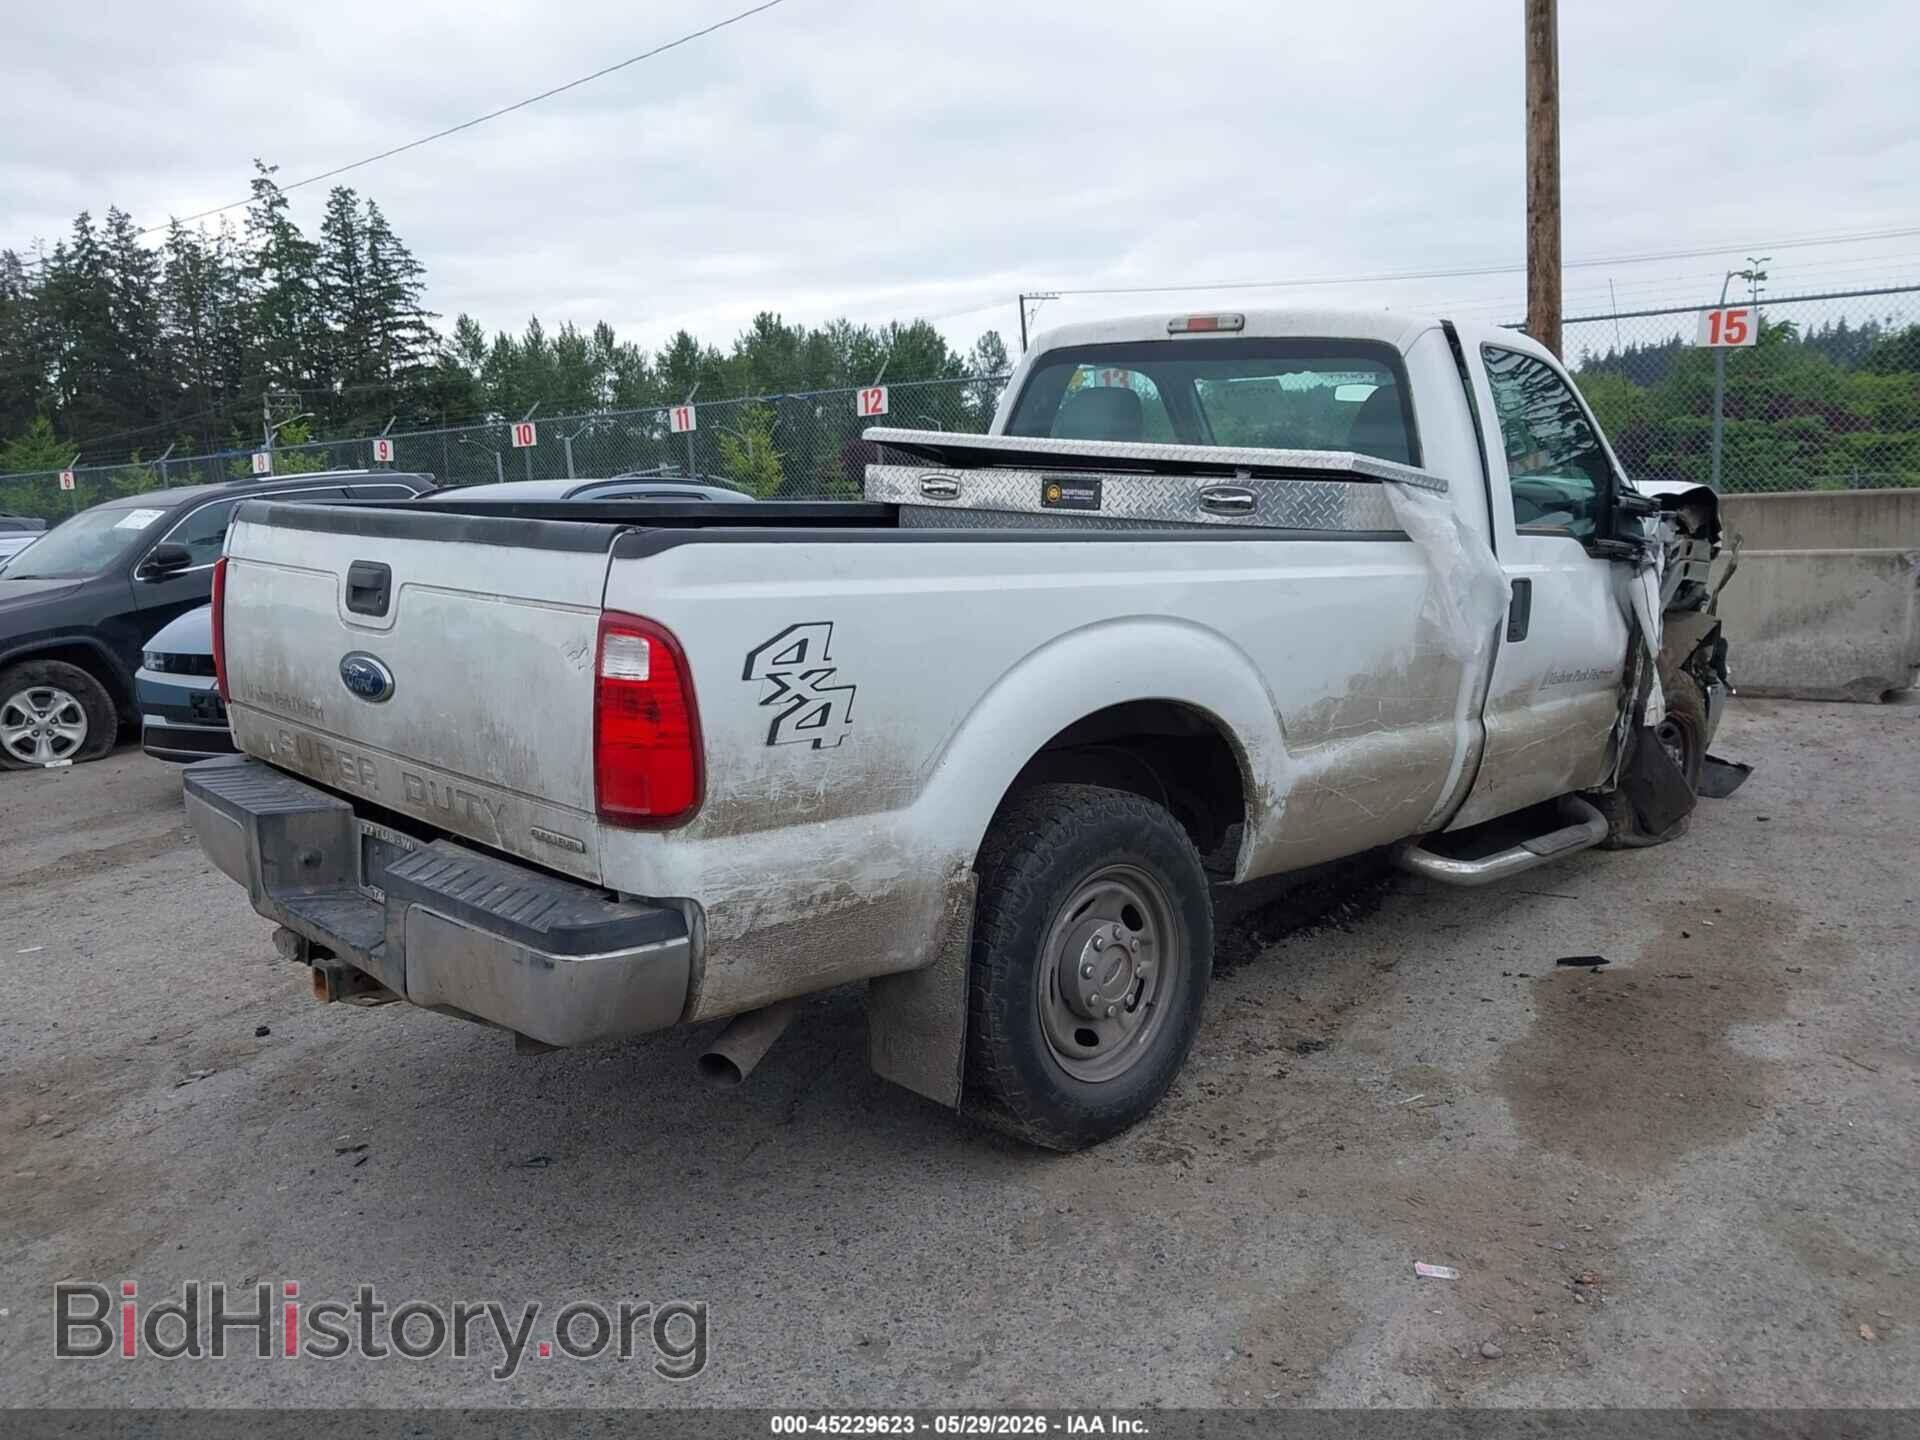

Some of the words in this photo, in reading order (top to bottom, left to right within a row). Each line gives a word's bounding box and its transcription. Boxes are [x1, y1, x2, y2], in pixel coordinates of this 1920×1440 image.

[1708, 310, 1748, 345] 15
[861, 388, 884, 414] 12
[675, 407, 690, 431] 11
[515, 424, 534, 446] 10
[378, 441, 389, 460] 9
[256, 454, 266, 473] 8
[63, 472, 72, 488] 6
[278, 729, 380, 791] SUPER
[401, 771, 504, 834] DUTY
